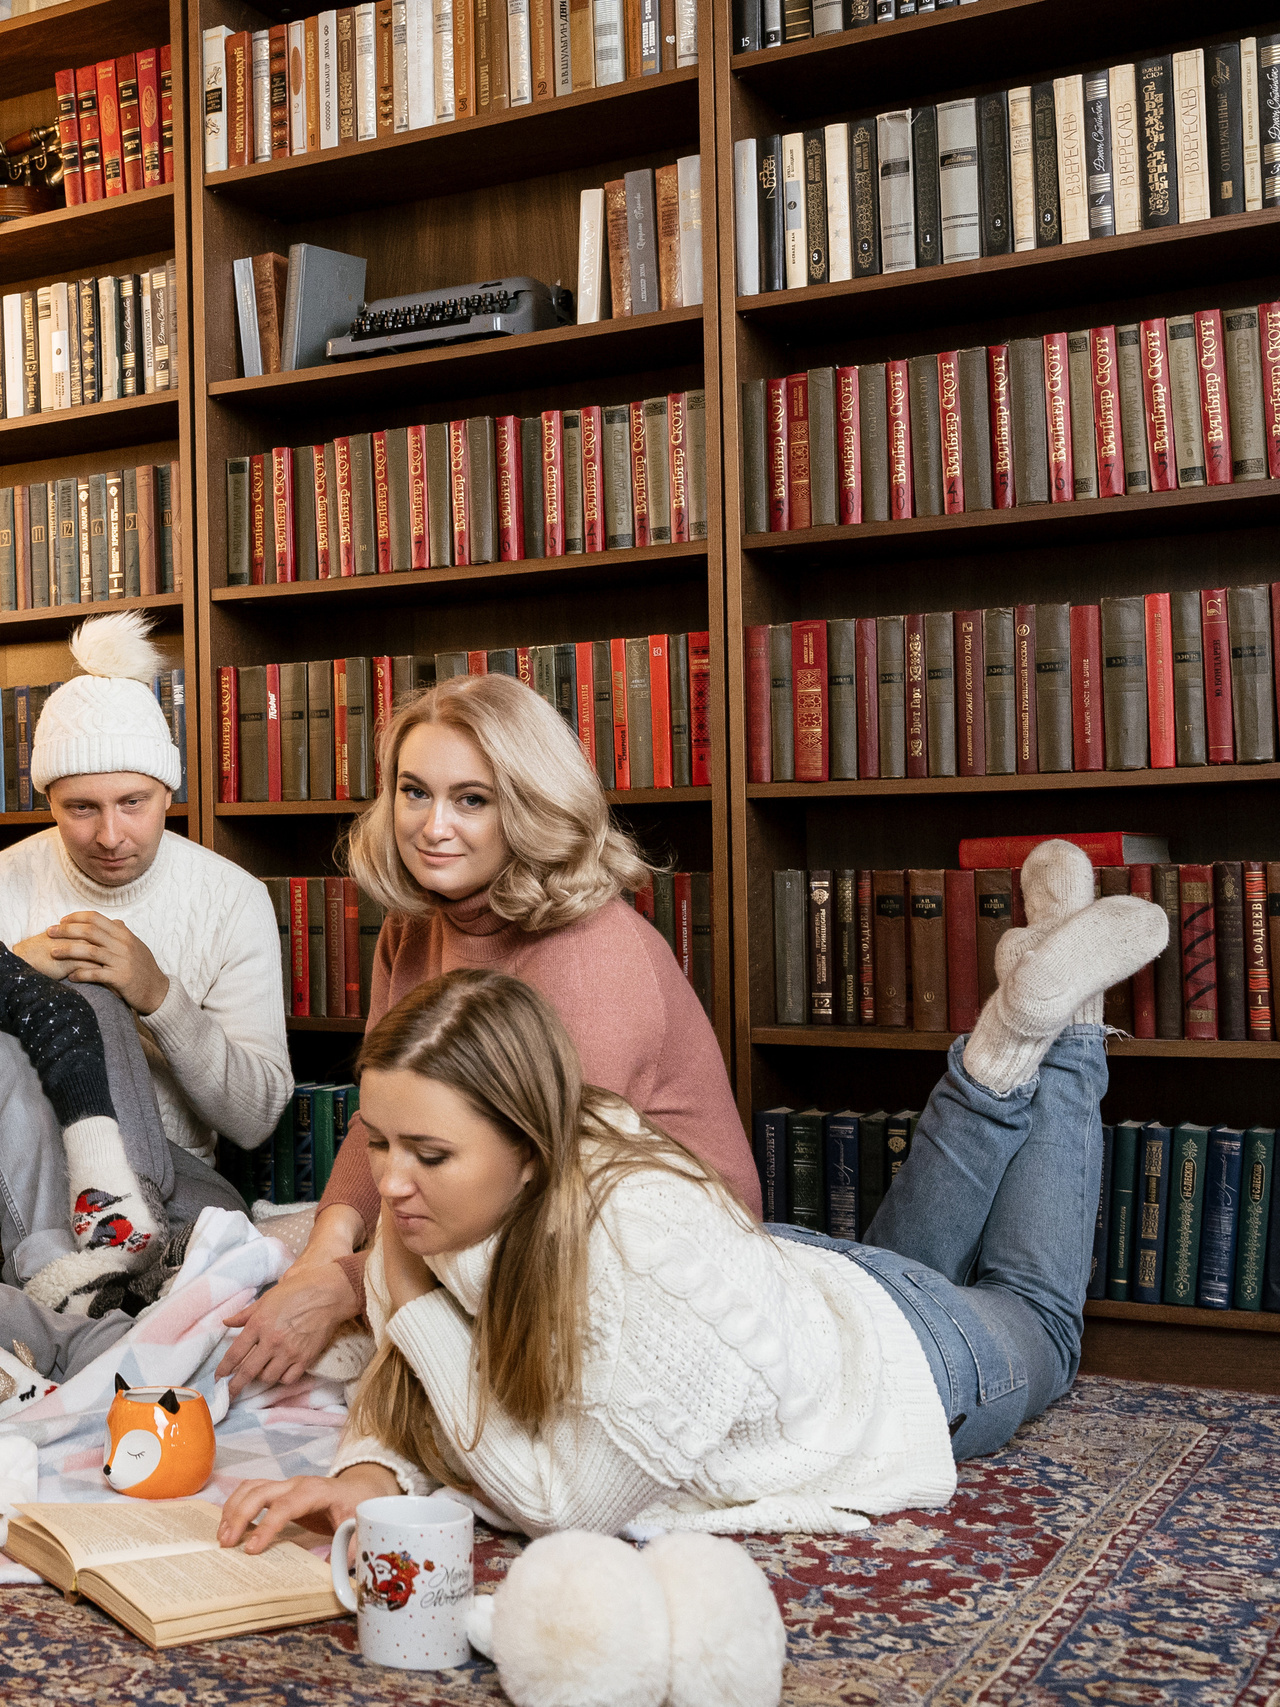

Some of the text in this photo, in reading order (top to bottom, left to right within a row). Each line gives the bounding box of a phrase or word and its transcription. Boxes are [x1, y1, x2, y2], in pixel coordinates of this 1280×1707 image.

[881, 4, 887, 12] 5
[740, 36, 750, 48] 15
[770, 34, 776, 42] 3
[537, 82, 548, 96] 2
[458, 98, 468, 112] 3
[236, 116, 244, 153] КИРИЛЛ
[1180, 88, 1200, 174] В.ВЕРЕСАЕВ
[1218, 93, 1230, 172] ОТВЕРЖЕННЫЕ
[1117, 102, 1135, 188] В.ВЕРЕСАЕВ
[1062, 114, 1080, 196] В.ВЕРЕСАЕВ
[1096, 194, 1106, 206] 4
[1044, 214, 1050, 222] 3
[812, 252, 818, 261] 3
[1054, 466, 1066, 491] 6
[62, 523, 72, 536] 12
[94, 520, 100, 534] 6
[2, 532, 8, 544] 9
[34, 528, 43, 541] 11
[113, 578, 118, 588] 1
[1020, 640, 1028, 668] РАССКАЗ
[173, 684, 184, 705] МОЭМ
[582, 684, 590, 724] ЗАПАДНЯ
[910, 687, 921, 735] Брет Гарт
[1022, 712, 1030, 760] СОВРЕМЕННЫЙ
[330, 902, 338, 957] ШОЛОХОВ
[861, 906, 870, 951] ФАДЕЕВ
[1252, 903, 1266, 966] А. ФАДЕЕВ
[863, 986, 870, 996] 3
[814, 998, 830, 1008] 1-2
[1257, 994, 1262, 1004] 1
